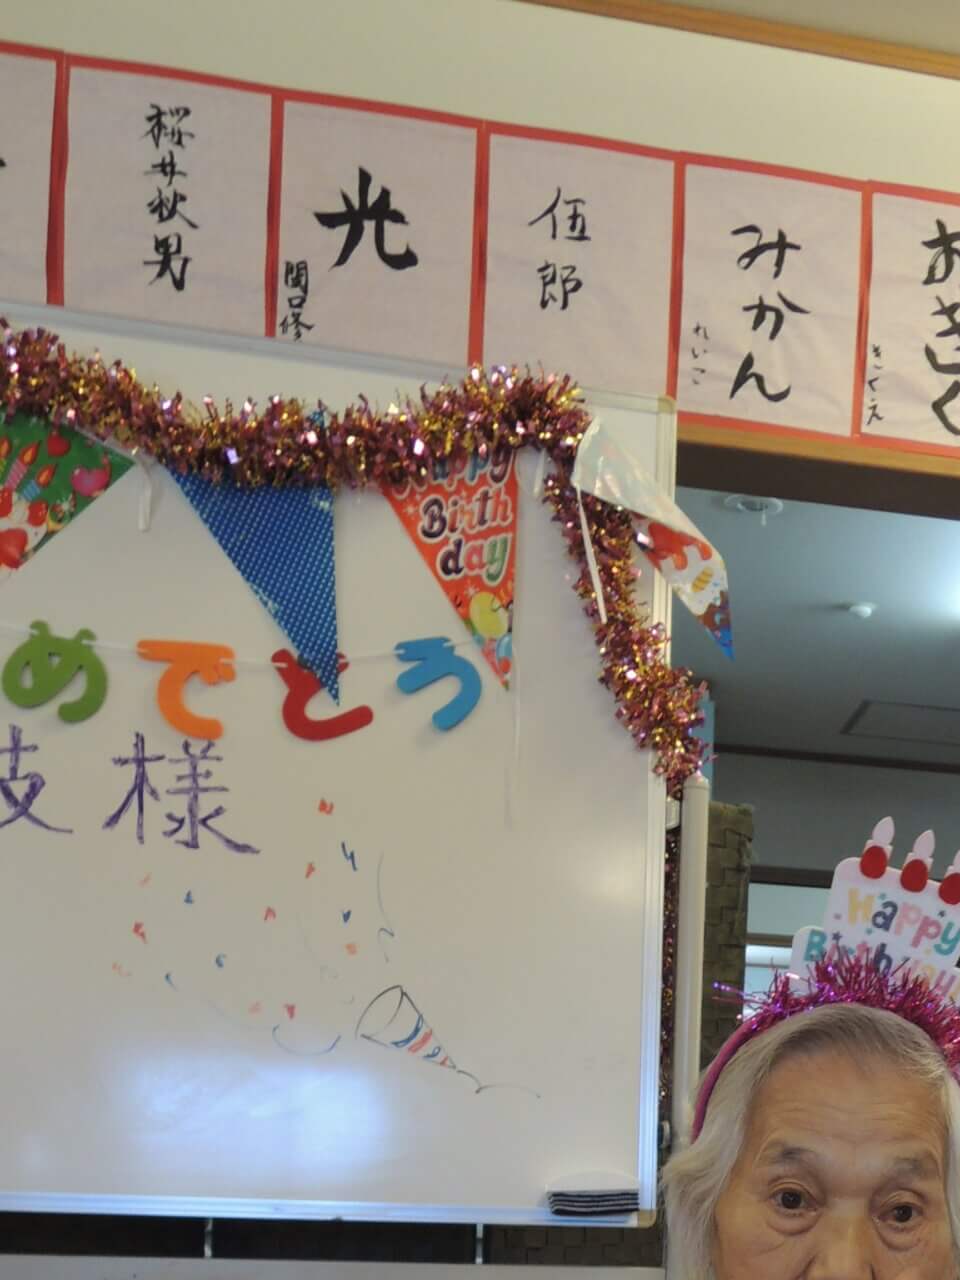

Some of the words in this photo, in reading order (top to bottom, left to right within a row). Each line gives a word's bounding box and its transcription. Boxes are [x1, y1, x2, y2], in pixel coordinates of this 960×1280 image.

[314, 166, 418, 271] 光
[730, 223, 811, 403] みかん
[419, 488, 513, 542] Birth
[436, 533, 513, 587] day
[2, 620, 482, 741] めでとう
